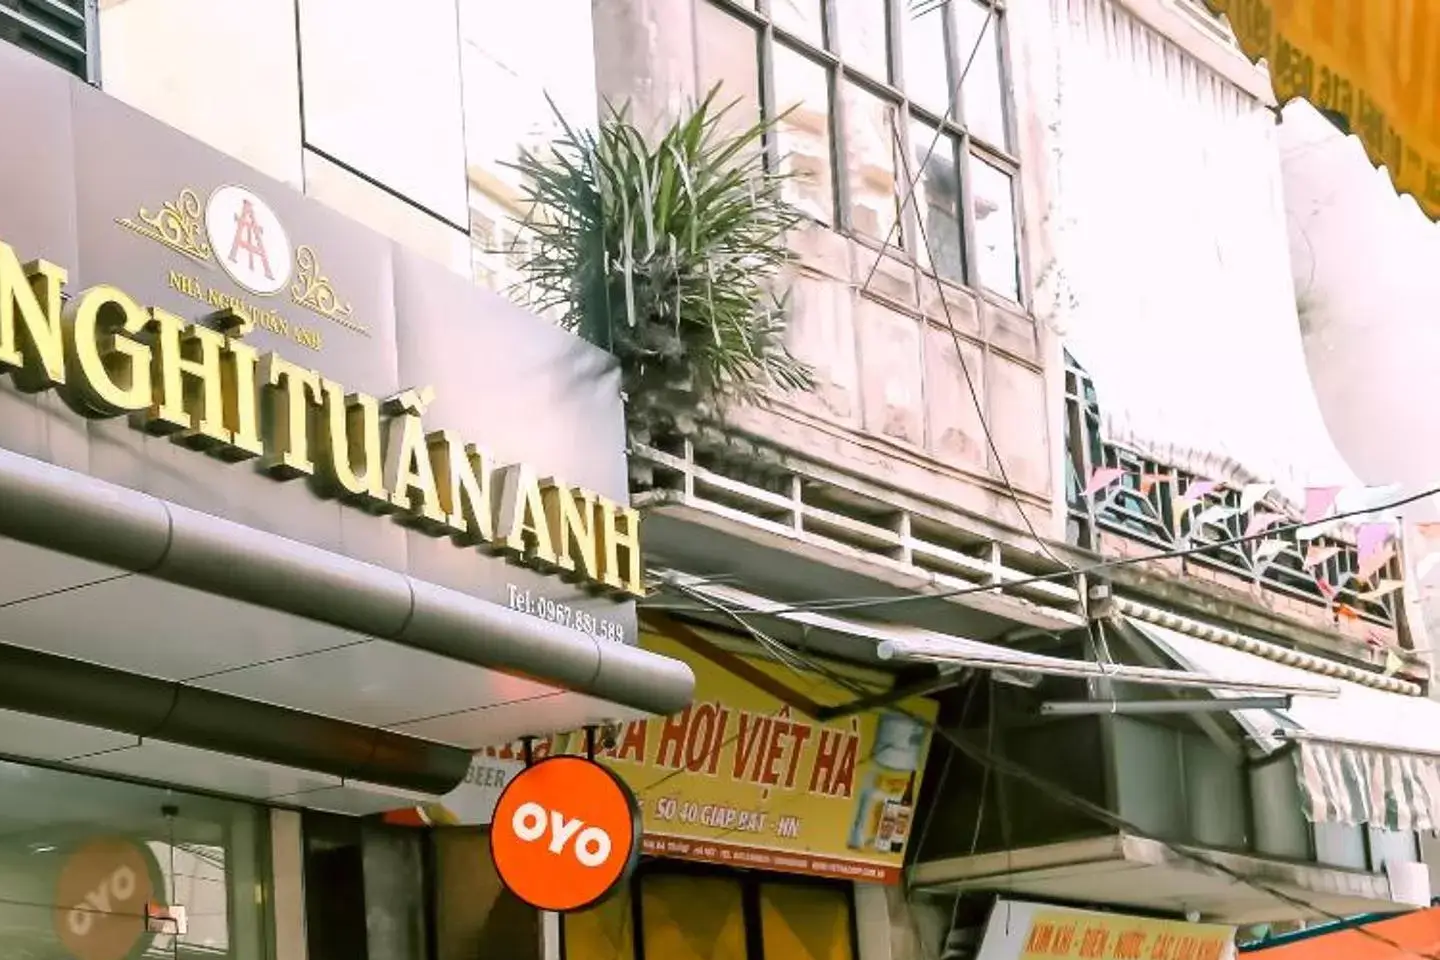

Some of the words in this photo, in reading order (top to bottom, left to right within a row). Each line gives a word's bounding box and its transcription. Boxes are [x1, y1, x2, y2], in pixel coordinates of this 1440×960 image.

[260, 352, 494, 543] TUẤN
[493, 462, 647, 597] ANH
[507, 583, 535, 613] Tel:
[732, 705, 810, 799] VIỆT
[809, 717, 859, 798] HÀ
[511, 800, 612, 868] OYO
